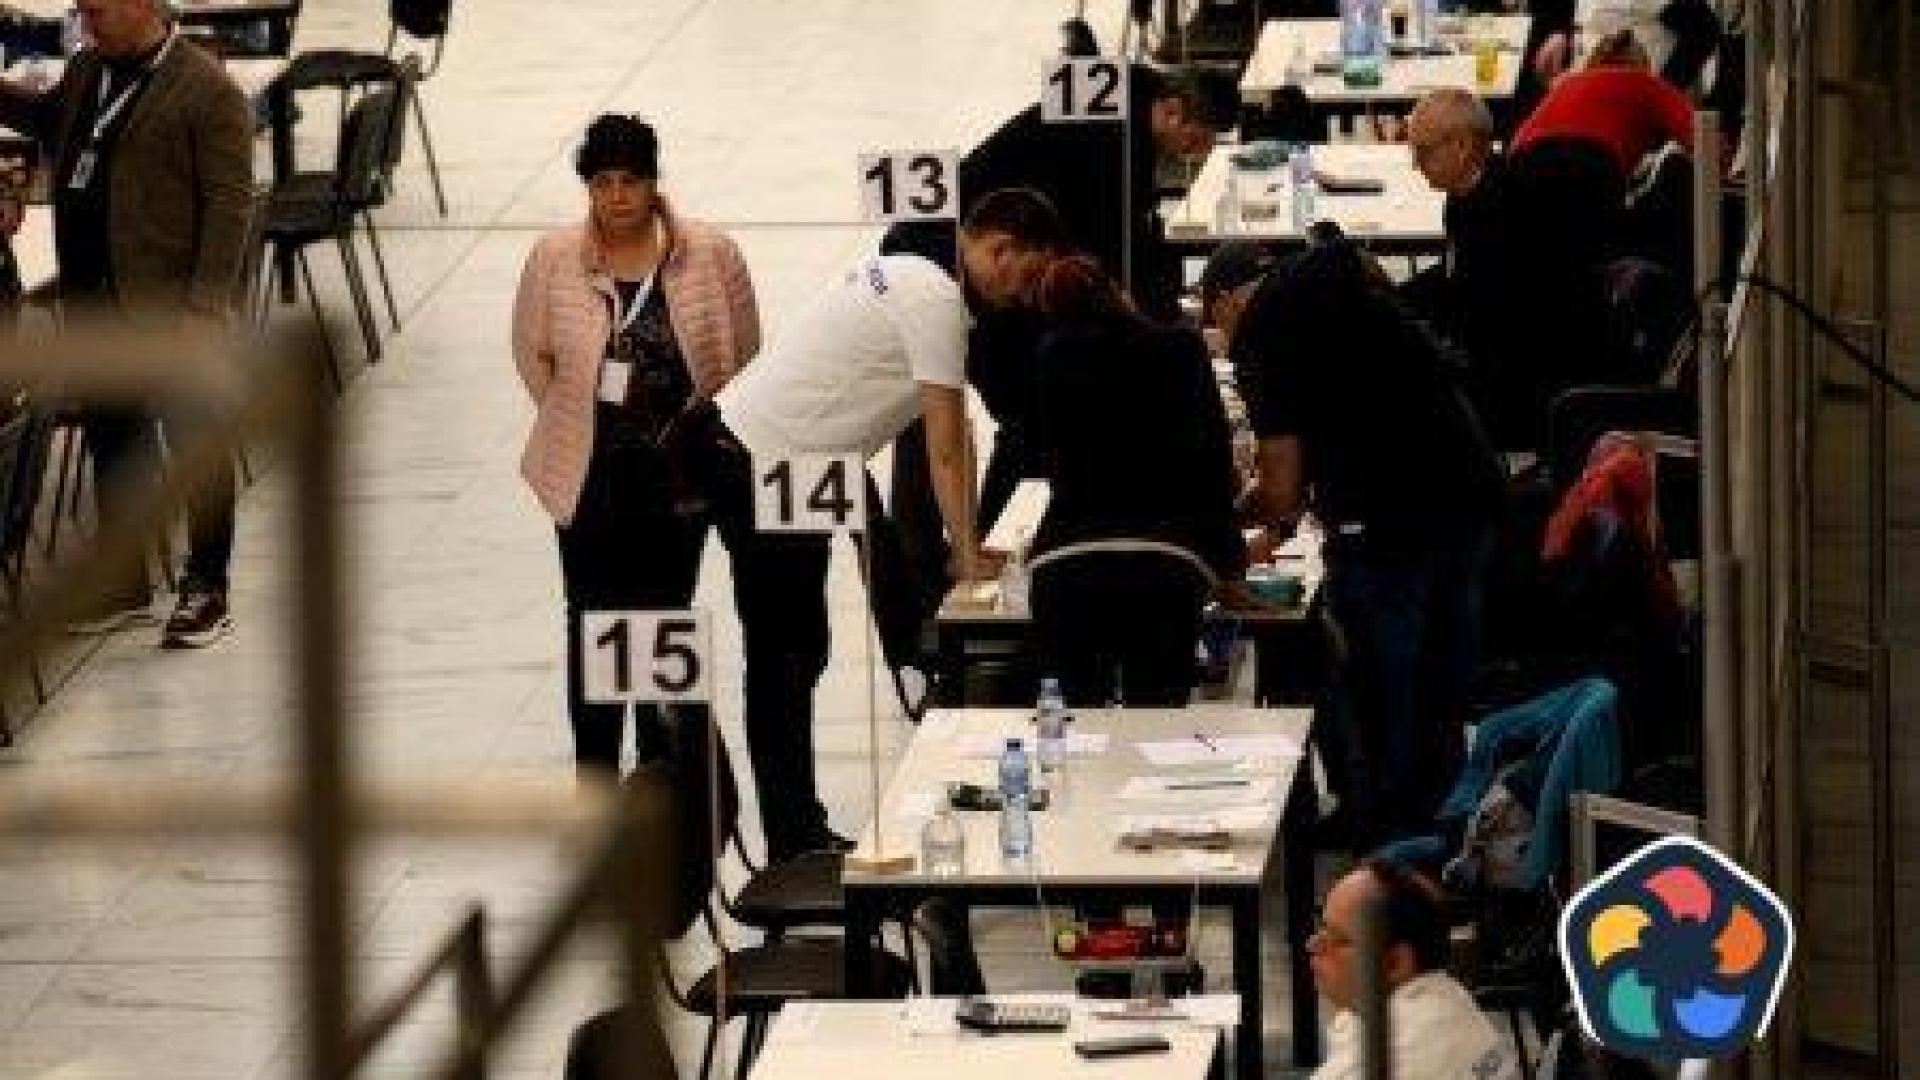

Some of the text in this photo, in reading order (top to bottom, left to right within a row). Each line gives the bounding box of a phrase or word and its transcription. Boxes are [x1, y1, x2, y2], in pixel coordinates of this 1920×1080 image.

[1049, 63, 1120, 116] 12
[865, 155, 949, 215] 13
[763, 459, 855, 526] 14
[595, 617, 702, 696] 15
